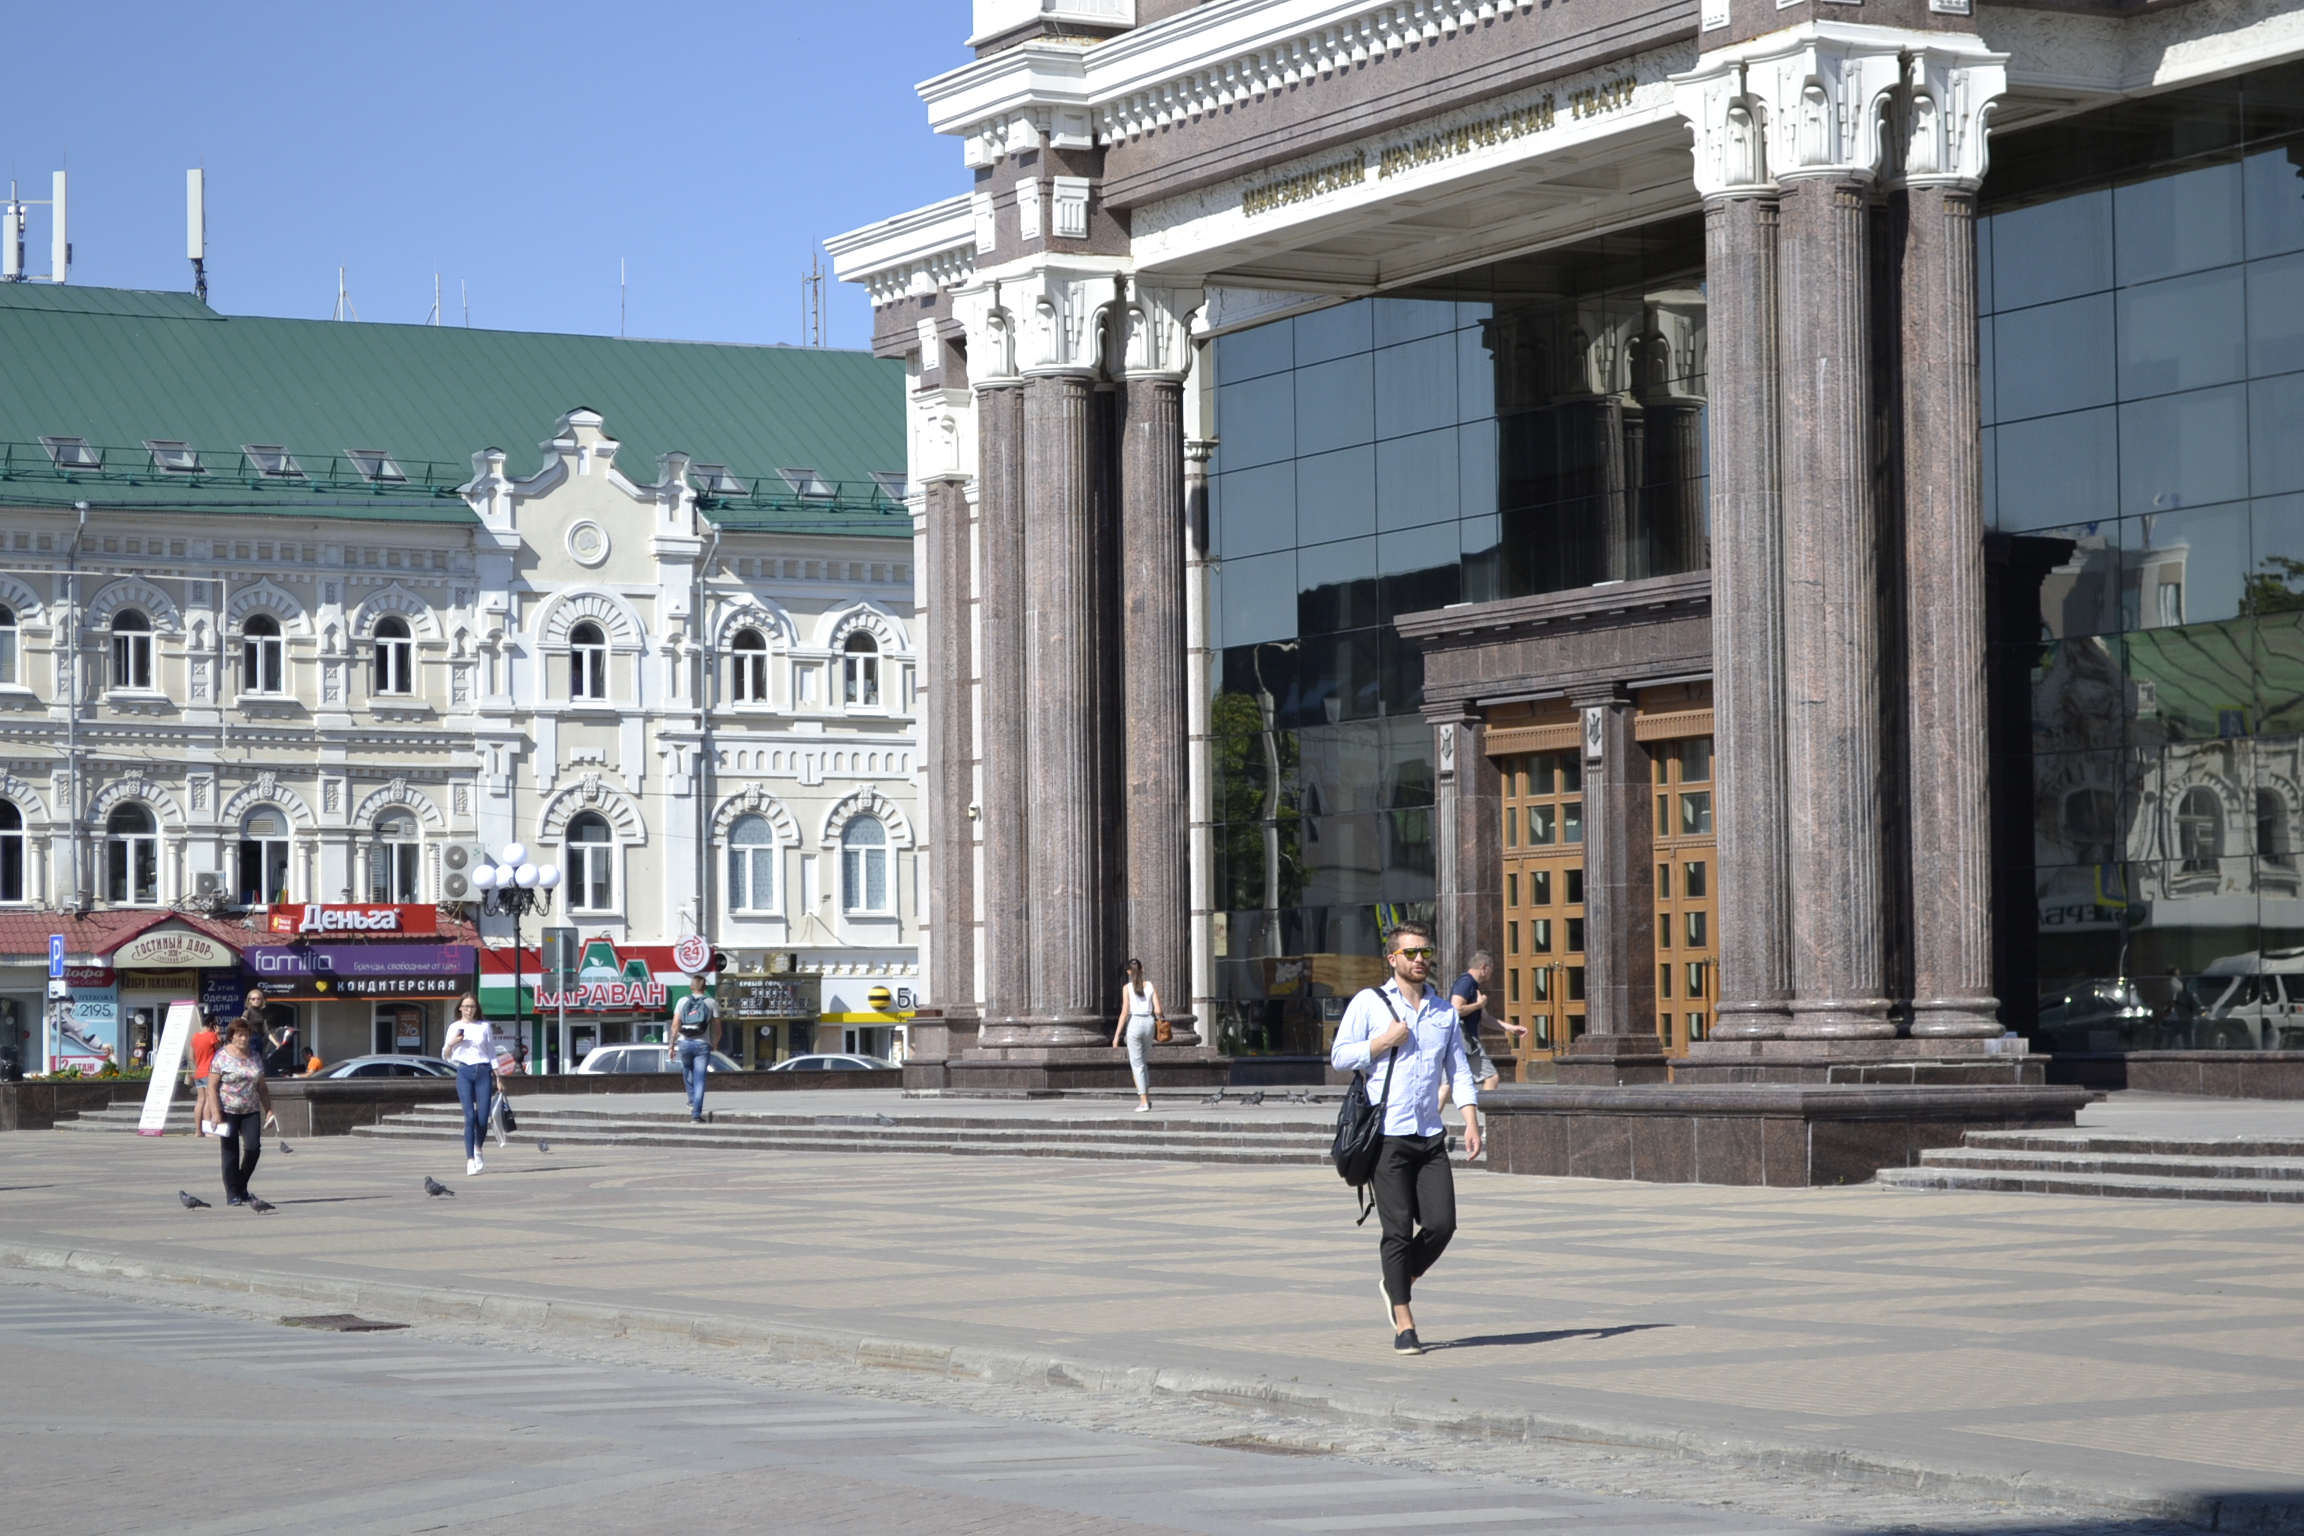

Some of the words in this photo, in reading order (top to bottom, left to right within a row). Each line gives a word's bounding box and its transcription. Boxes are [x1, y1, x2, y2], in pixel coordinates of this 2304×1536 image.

[1378, 93, 1556, 181] ДРАМАТИЧЕСКИЙ
[1568, 76, 1637, 119] ТЕАТР
[299, 905, 397, 932] Деньга
[135, 935, 183, 957] ГОСТИНЫЙ
[185, 938, 211, 956] ДВОР
[684, 946, 700, 956] 24
[255, 951, 333, 971] familia
[354, 961, 385, 971] Бренды,
[387, 962, 430, 971] свободные
[207, 980, 216, 991] 2
[337, 980, 455, 992] КОНДИТЕРСКАЯ
[203, 993, 239, 1003] Одежда
[535, 982, 666, 1006] КАРАВАН
[212, 1004, 230, 1012] для
